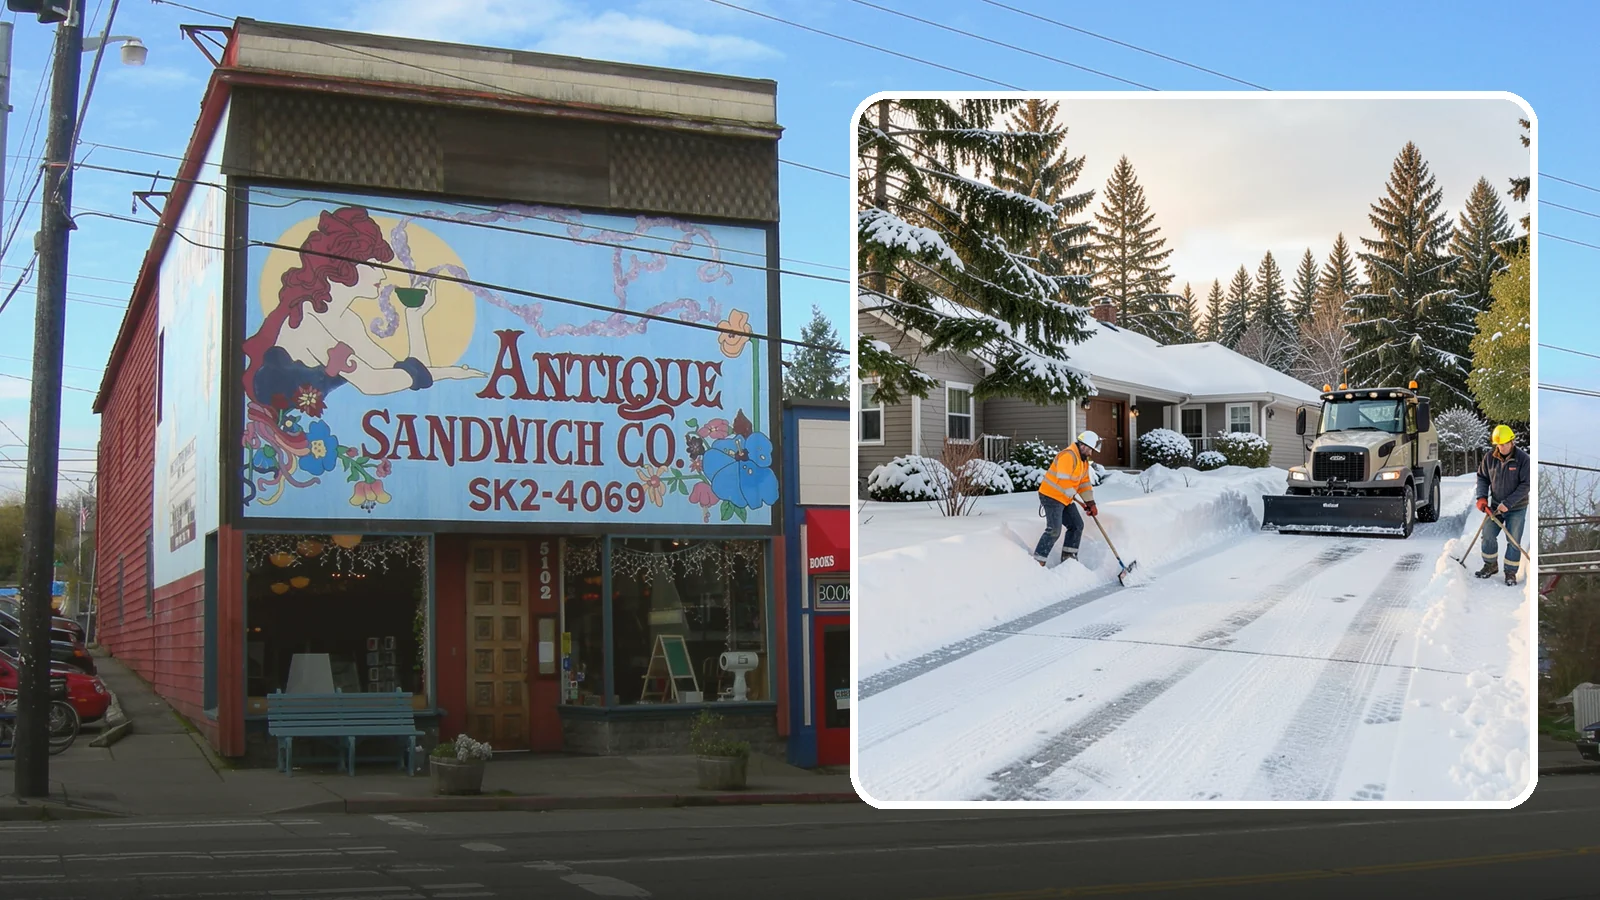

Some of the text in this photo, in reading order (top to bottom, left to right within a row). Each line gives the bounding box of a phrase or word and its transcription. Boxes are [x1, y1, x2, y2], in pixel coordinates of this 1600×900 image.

[475, 329, 724, 420] ANTIQUE
[361, 409, 685, 469] SANDWICH CO.
[468, 477, 646, 513] SK2-4069
[540, 542, 552, 599] 5102
[809, 555, 835, 569] BOOKS
